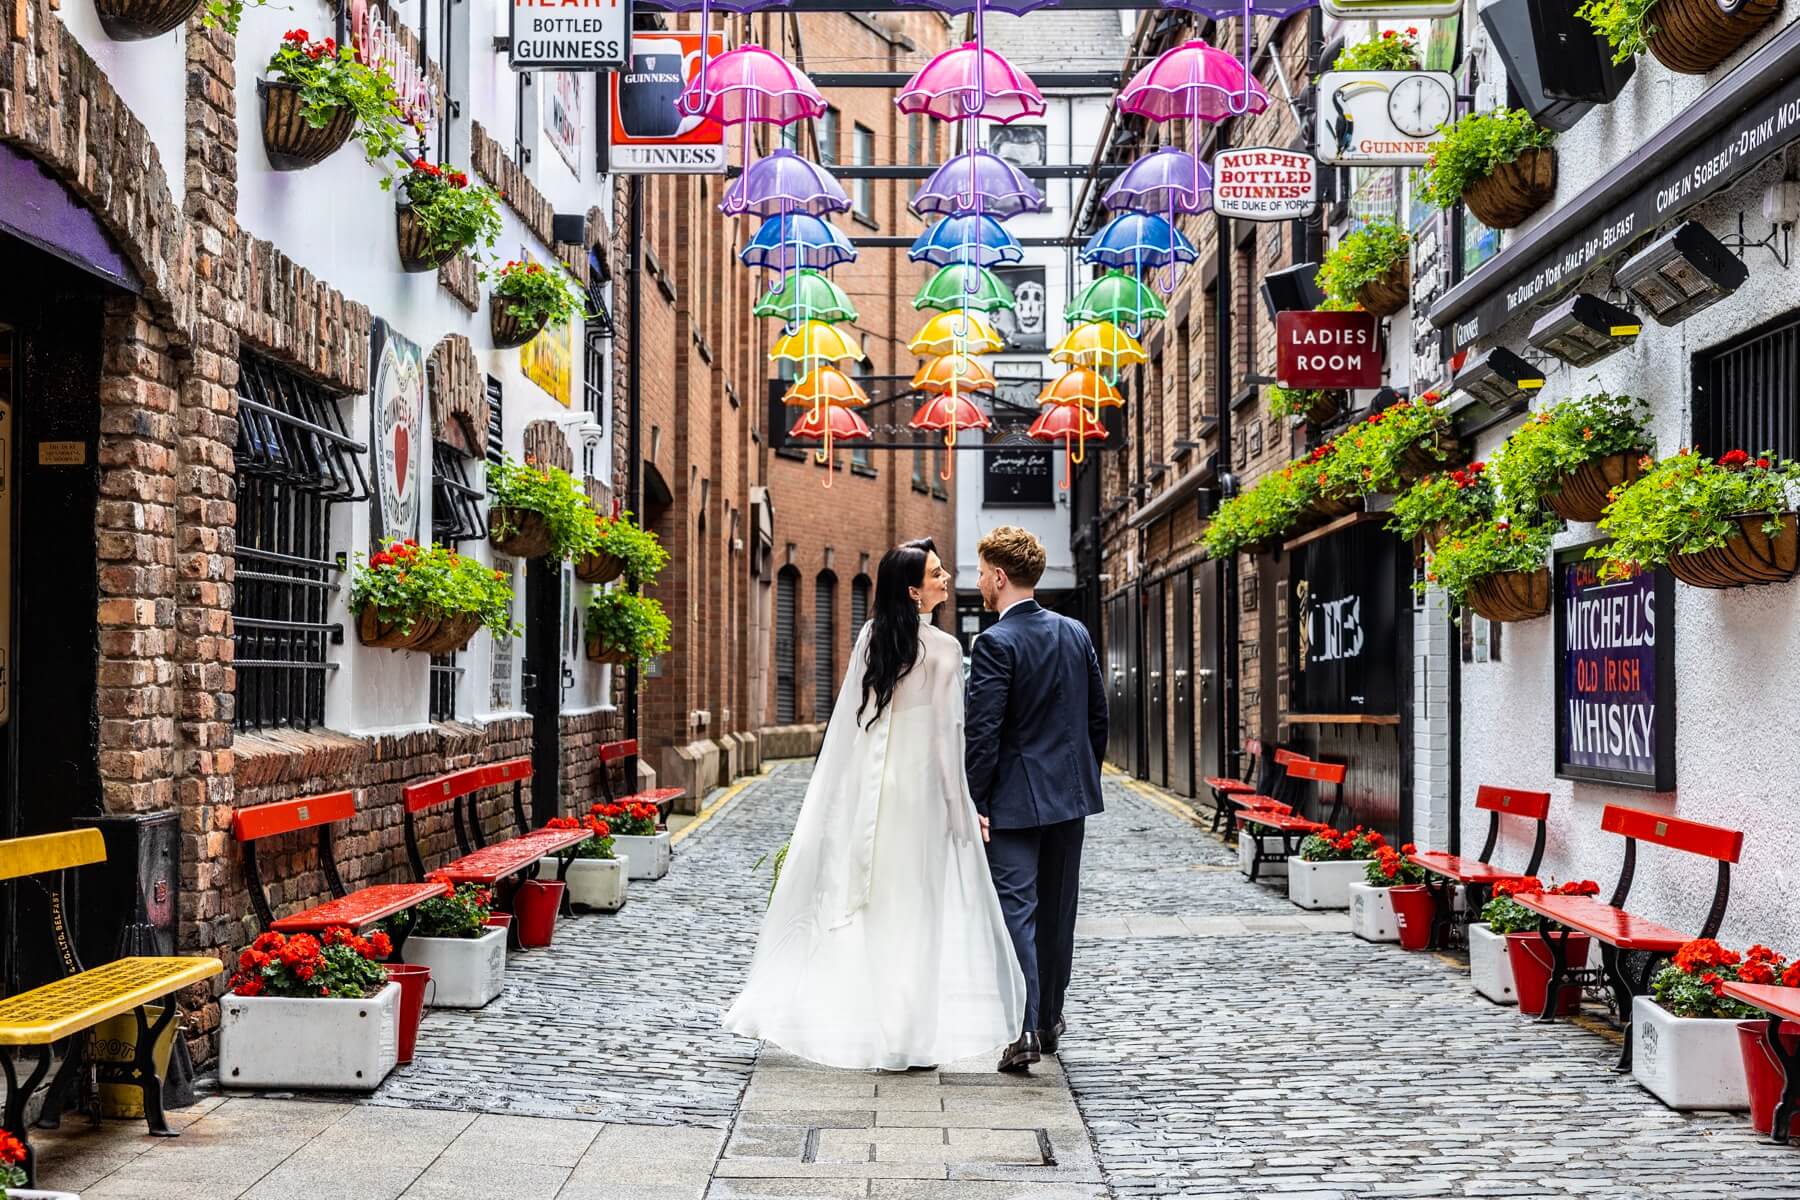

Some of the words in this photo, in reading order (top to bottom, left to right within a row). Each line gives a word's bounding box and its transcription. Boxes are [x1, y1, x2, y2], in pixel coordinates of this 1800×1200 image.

[533, 19, 602, 33] BOTTLED
[517, 40, 619, 59] GUINNESS
[624, 73, 680, 84] GUINNESS
[1222, 153, 1312, 170] MURPHY
[1656, 180, 1680, 213] COME
[1681, 173, 1692, 197] IN
[1693, 143, 1735, 189] SOBERLY
[1739, 115, 1775, 156] DRINK
[1221, 171, 1312, 184] BOTTLED
[1221, 200, 1239, 210] THE
[1242, 201, 1267, 211] DUKE
[1269, 201, 1282, 211] OF
[1284, 200, 1309, 210] YORK
[1506, 291, 1518, 312] THE
[1518, 279, 1535, 304] DUKE
[1535, 273, 1545, 293] OF
[1545, 263, 1562, 287] YORK
[1564, 247, 1585, 275] HALF
[1585, 238, 1598, 262] BAP
[1602, 212, 1635, 250] BELFAST
[1292, 329, 1367, 345] LADIES
[1297, 355, 1361, 371] ROOM
[1566, 587, 1656, 651] MITCHELL'S
[1576, 658, 1598, 692] OLD
[1604, 655, 1641, 692] IRISH
[1569, 698, 1655, 758] WHISKY
[52, 892, 63, 931] BELFAST
